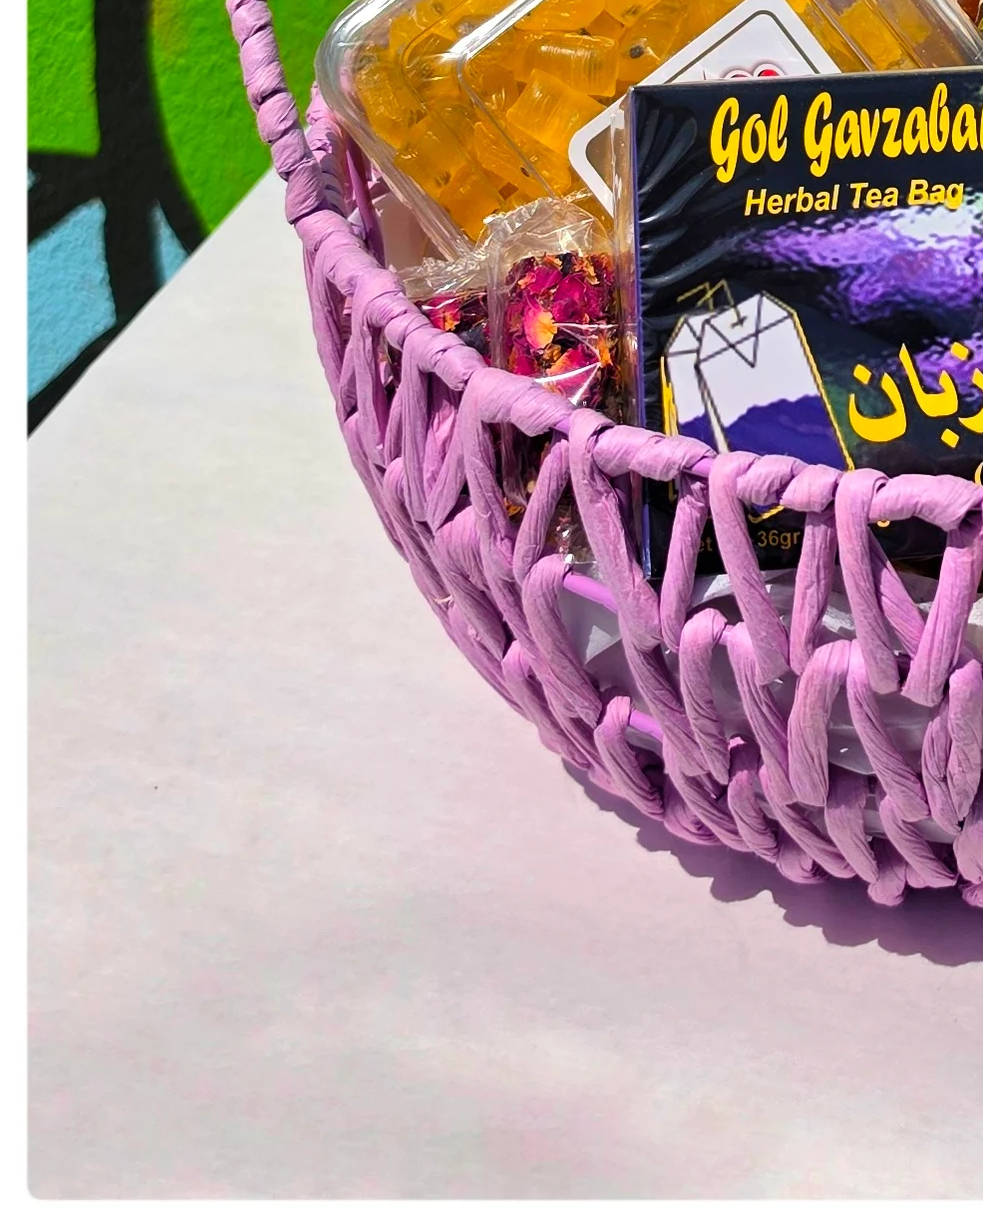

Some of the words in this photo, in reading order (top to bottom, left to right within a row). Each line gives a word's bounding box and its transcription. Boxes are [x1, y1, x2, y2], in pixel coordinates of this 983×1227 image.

[711, 93, 788, 183] Gol
[745, 184, 840, 216] Herbal
[850, 180, 902, 209] Tea
[908, 178, 965, 210] Bag
